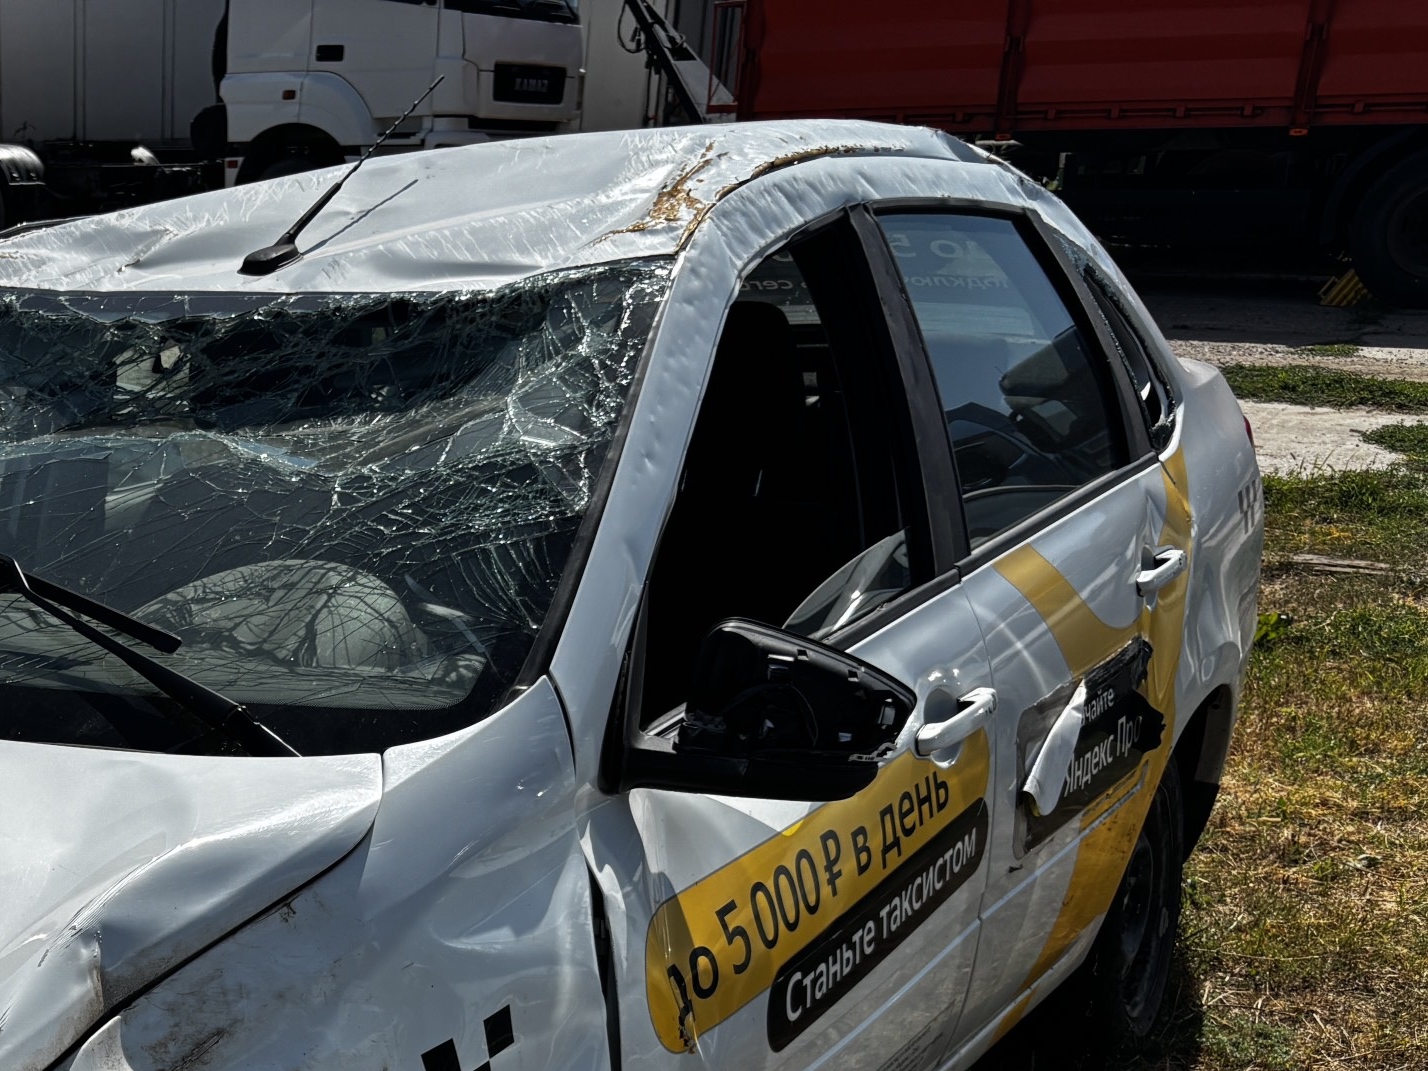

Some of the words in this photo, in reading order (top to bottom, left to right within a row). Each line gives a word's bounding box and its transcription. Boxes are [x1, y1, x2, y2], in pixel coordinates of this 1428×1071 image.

[1116, 715, 1143, 759] Про
[850, 825, 872, 877] в
[878, 770, 950, 870] день
[785, 919, 876, 1022] Станьте
[879, 827, 977, 940] таксистом
